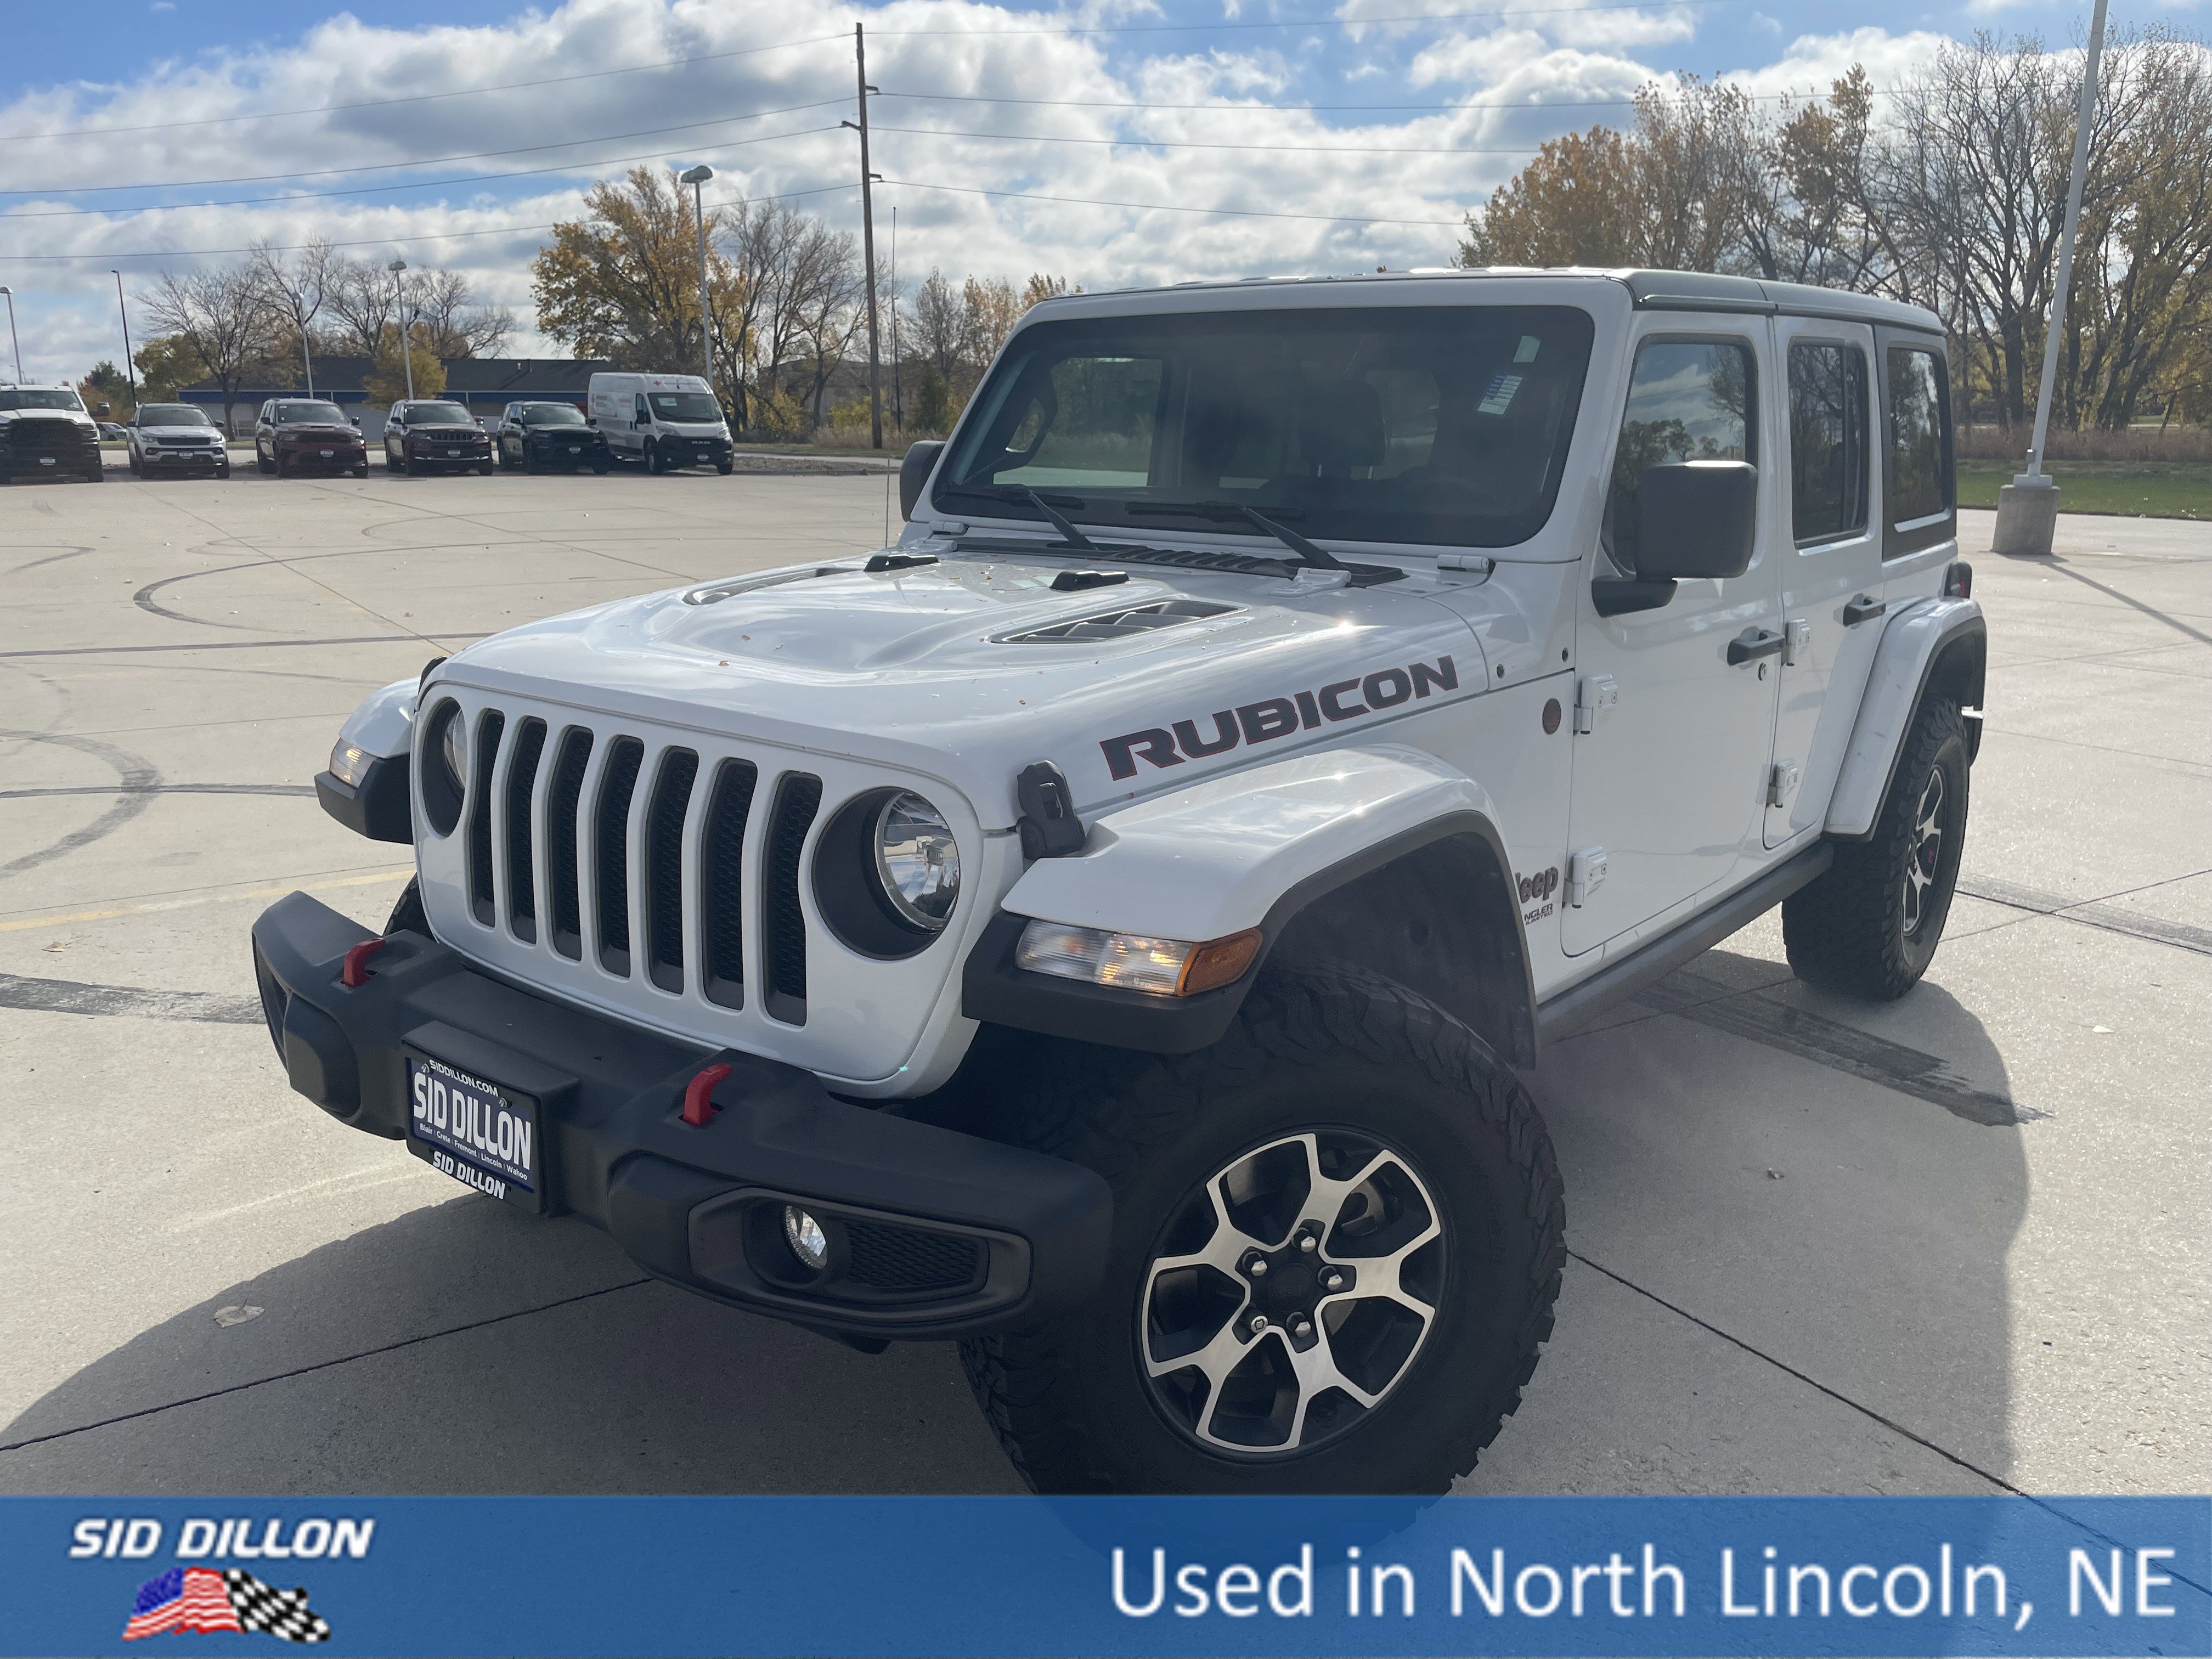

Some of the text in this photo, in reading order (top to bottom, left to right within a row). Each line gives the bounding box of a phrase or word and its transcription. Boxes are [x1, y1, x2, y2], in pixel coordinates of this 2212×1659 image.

[1099, 655, 1459, 781] RUBICON
[430, 1059, 499, 1097] SIDDILLON.COM
[414, 1072, 531, 1170] SID DILLON
[420, 1123, 433, 1135] Blair
[454, 1140, 477, 1156] Fremont
[481, 1153, 503, 1169] Lincoln
[506, 1164, 528, 1181] Wahoo
[433, 1150, 506, 1200] SID DILLON
